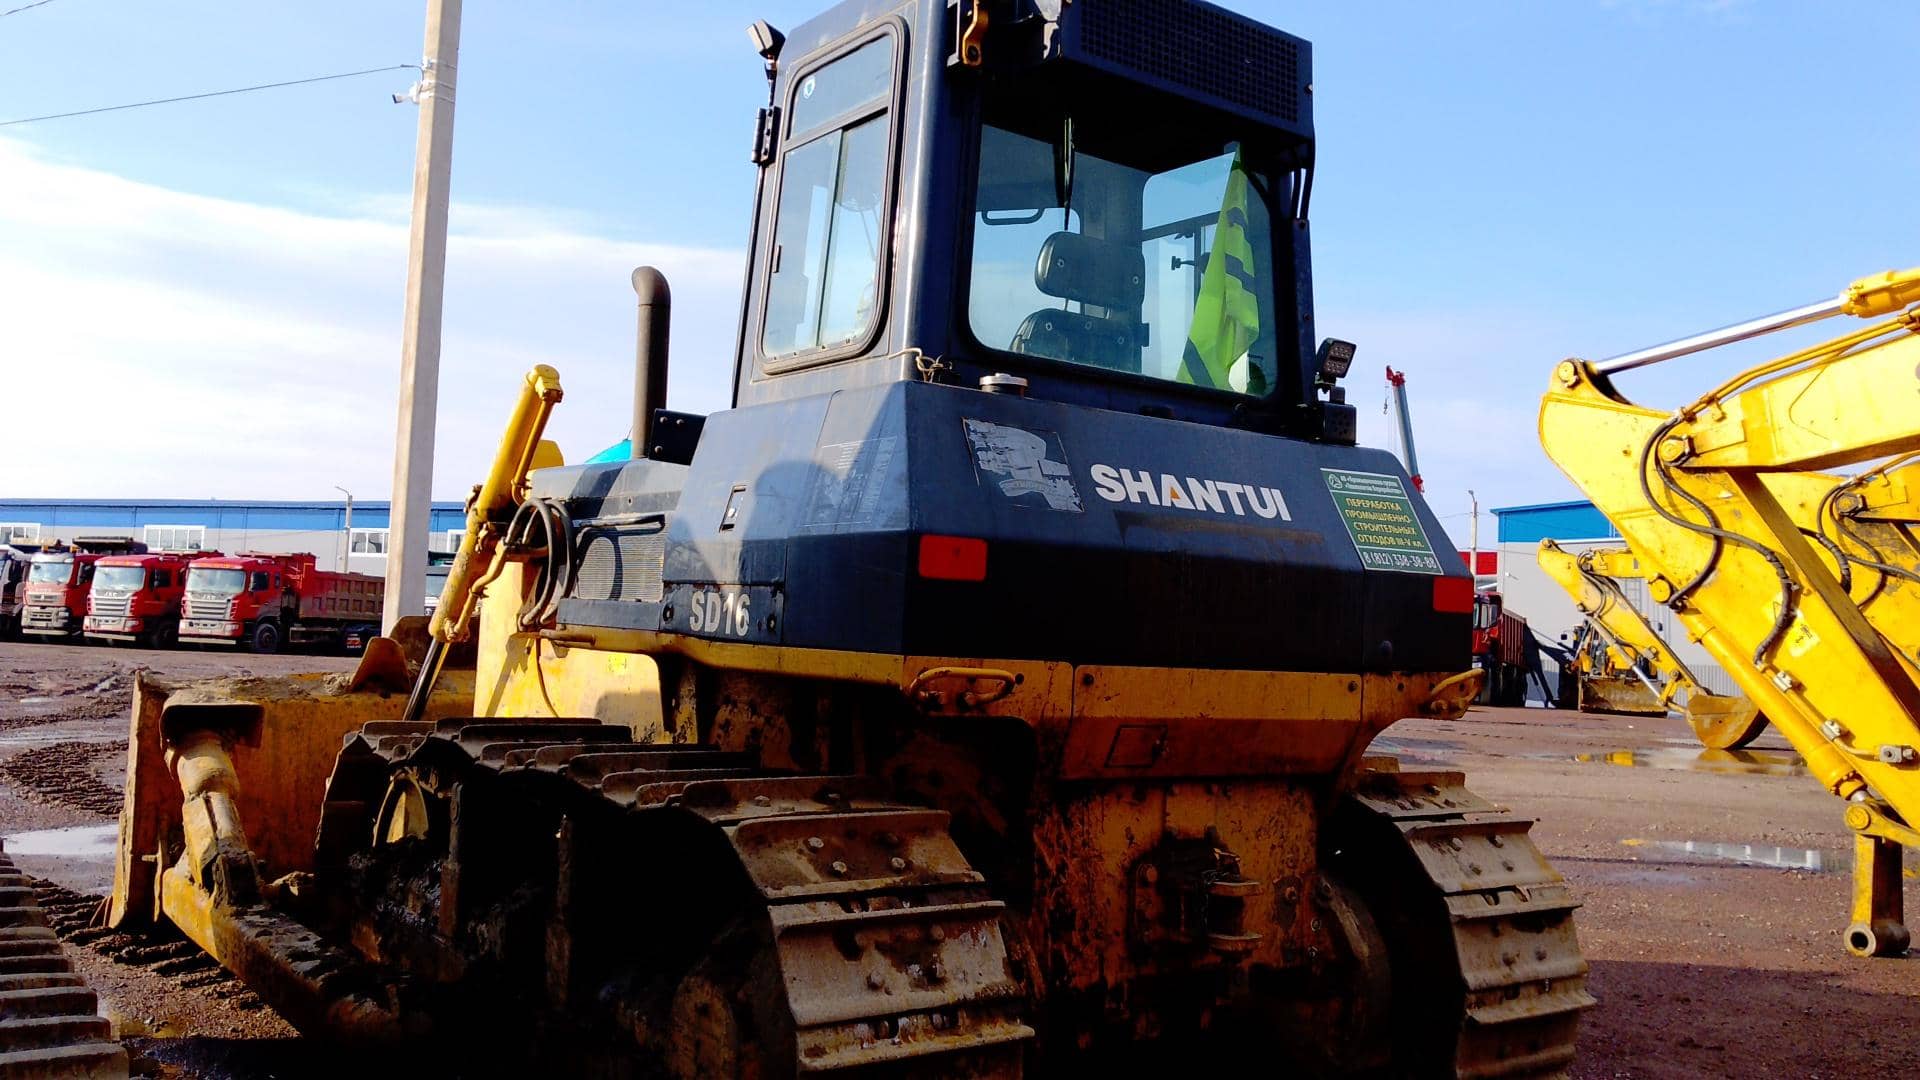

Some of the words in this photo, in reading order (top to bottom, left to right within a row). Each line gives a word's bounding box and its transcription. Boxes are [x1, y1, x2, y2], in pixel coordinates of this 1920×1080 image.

[1090, 463, 1292, 522] SHANTUI
[1346, 498, 1401, 511] ПЕРЕРАБОТКА
[1353, 522, 1416, 535] СТРОИТЕЛЬНЫХ
[1357, 534, 1396, 546] ОТХОДОВ
[1371, 552, 1393, 566] (812)
[689, 591, 751, 637] SD16
